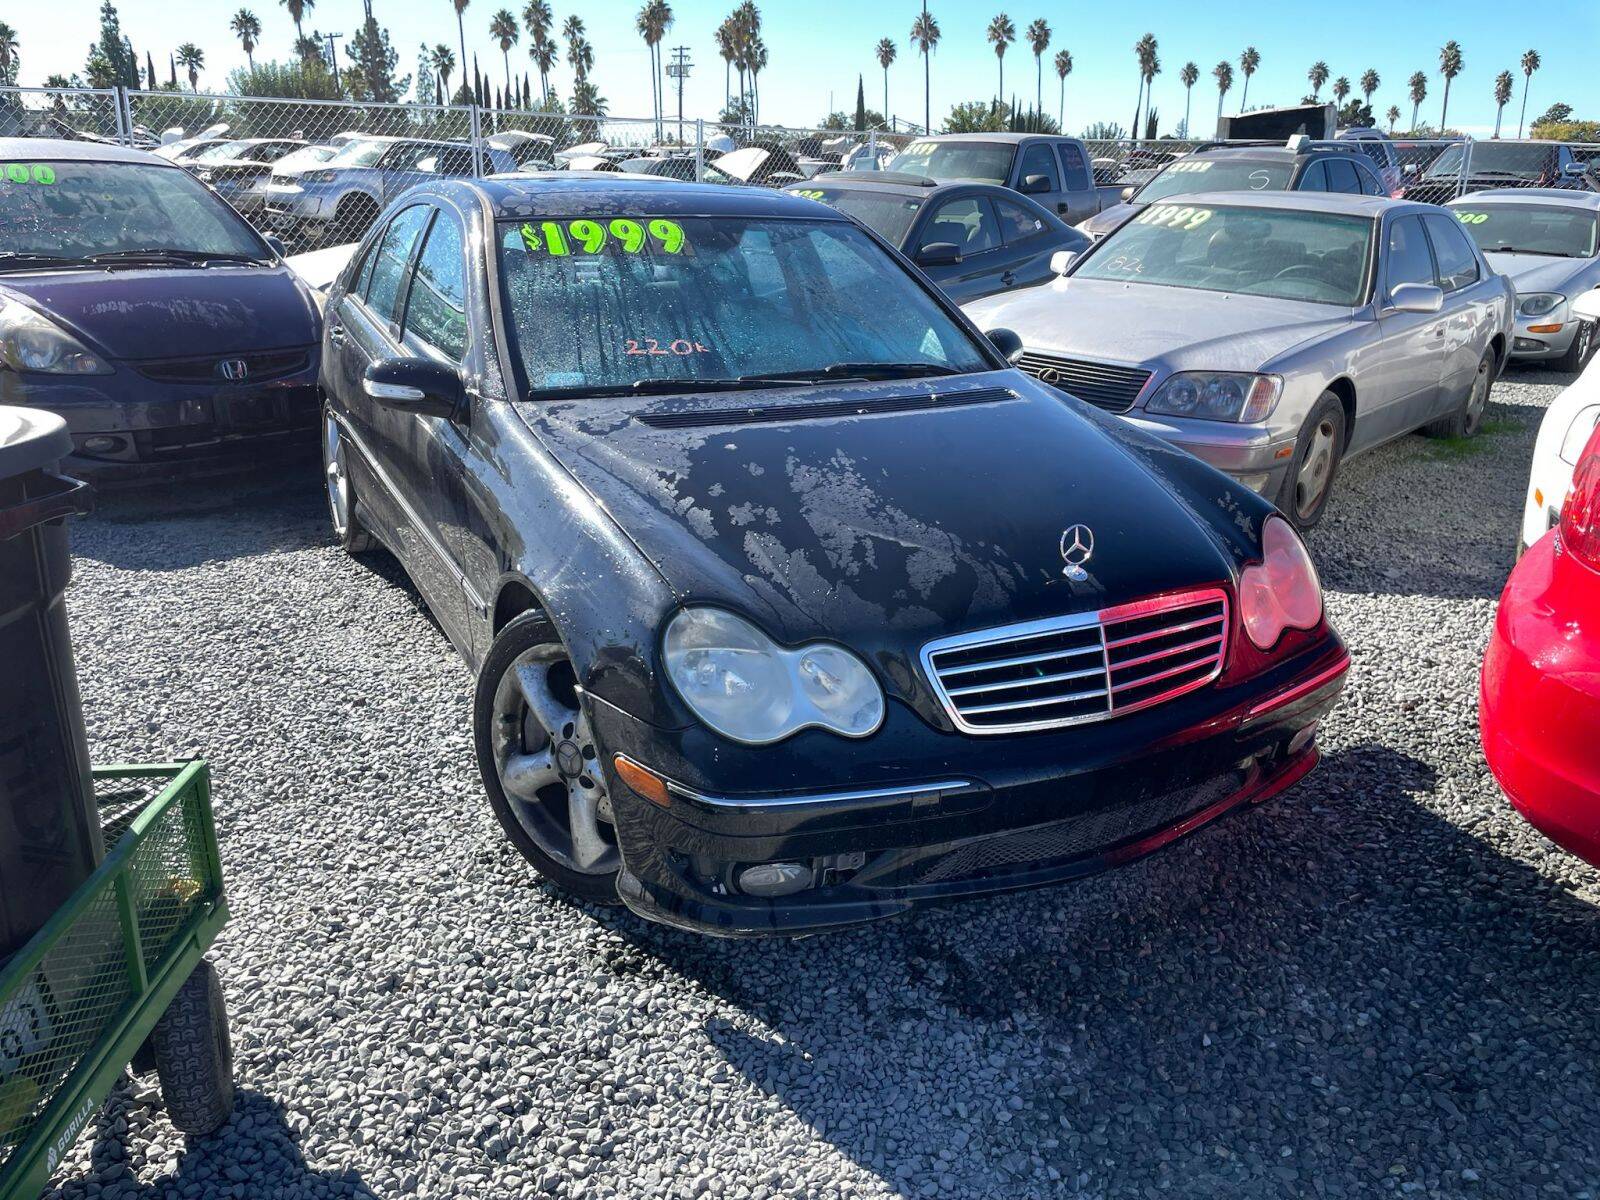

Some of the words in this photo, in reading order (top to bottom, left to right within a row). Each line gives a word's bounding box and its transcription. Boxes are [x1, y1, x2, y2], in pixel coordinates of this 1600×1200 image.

[0, 163, 55, 185] 00
[521, 219, 686, 256] $1999
[57, 1097, 94, 1152] GORILLA
